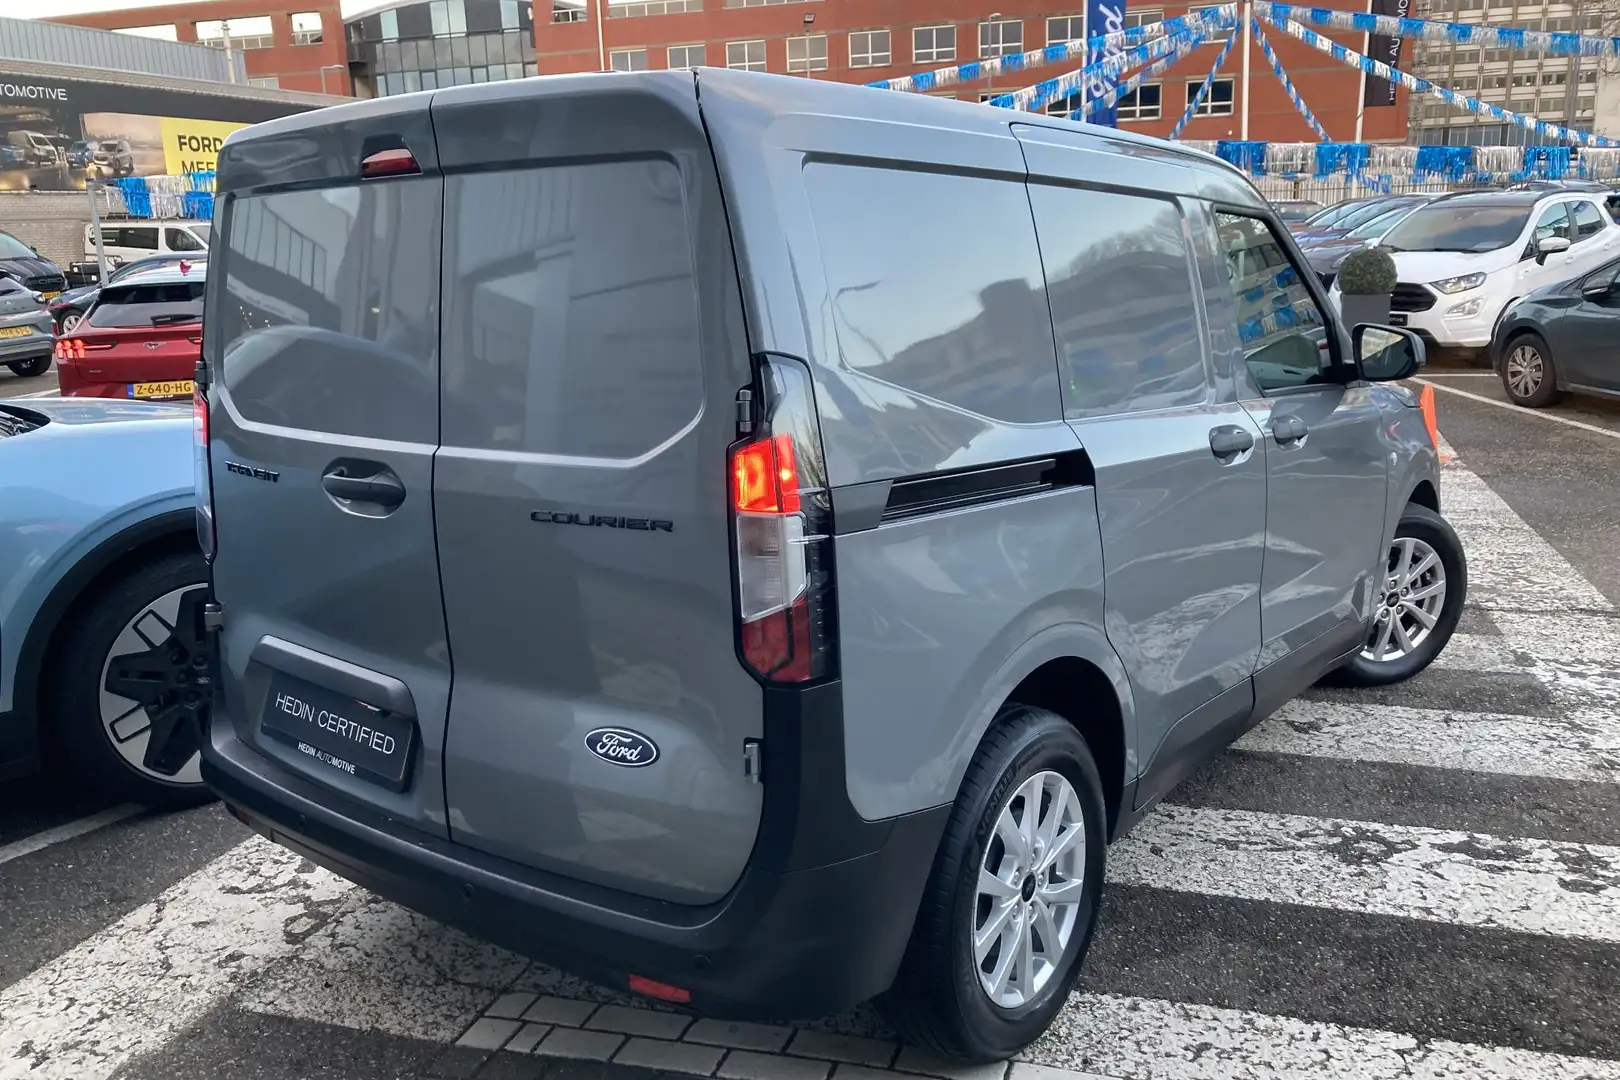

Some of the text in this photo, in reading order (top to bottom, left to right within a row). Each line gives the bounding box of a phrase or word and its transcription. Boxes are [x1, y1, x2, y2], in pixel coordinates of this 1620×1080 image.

[1091, 3, 1123, 109] Fd
[1389, 60, 1397, 101] HEN
[177, 134, 223, 153] FORD
[136, 382, 192, 395] Z-640-HG
[530, 509, 674, 533] COURIER
[275, 692, 396, 755] HEDIN CERTIFIED
[297, 741, 356, 775] HEDIN AUTOMOTIVE
[596, 732, 643, 761] Ford
